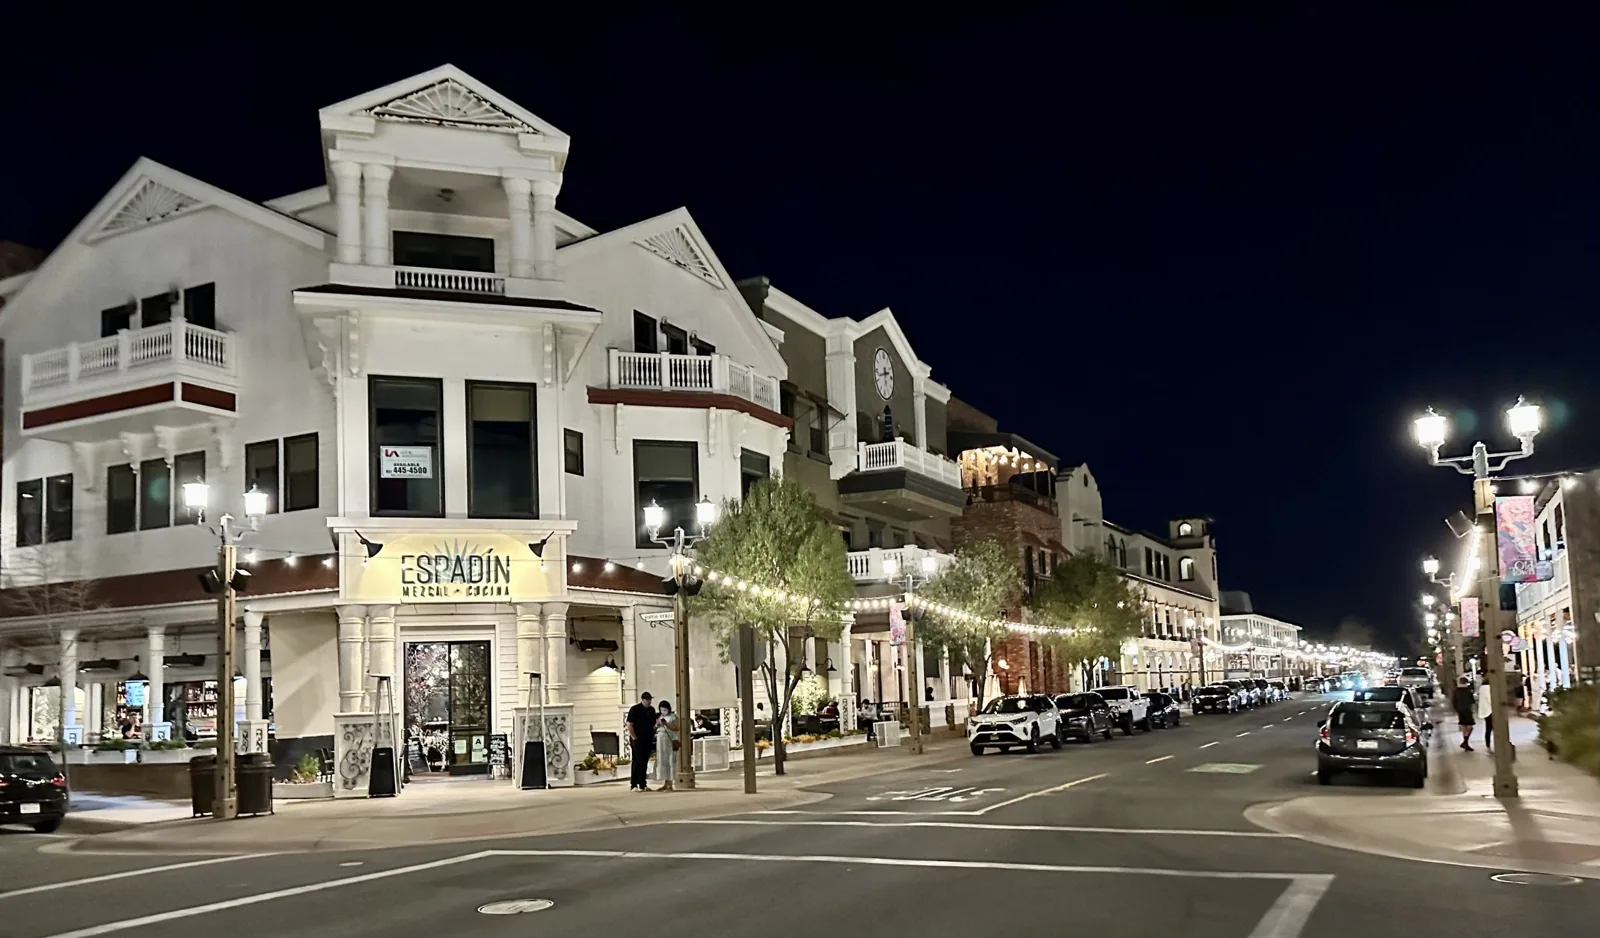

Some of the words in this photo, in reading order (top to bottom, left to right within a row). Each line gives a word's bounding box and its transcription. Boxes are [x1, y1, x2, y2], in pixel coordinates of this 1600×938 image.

[402, 549, 510, 584] ESPADÍN
[1514, 560, 1534, 571] Old
[402, 586, 449, 597] MEZCAL
[466, 585, 509, 597] COCINA
